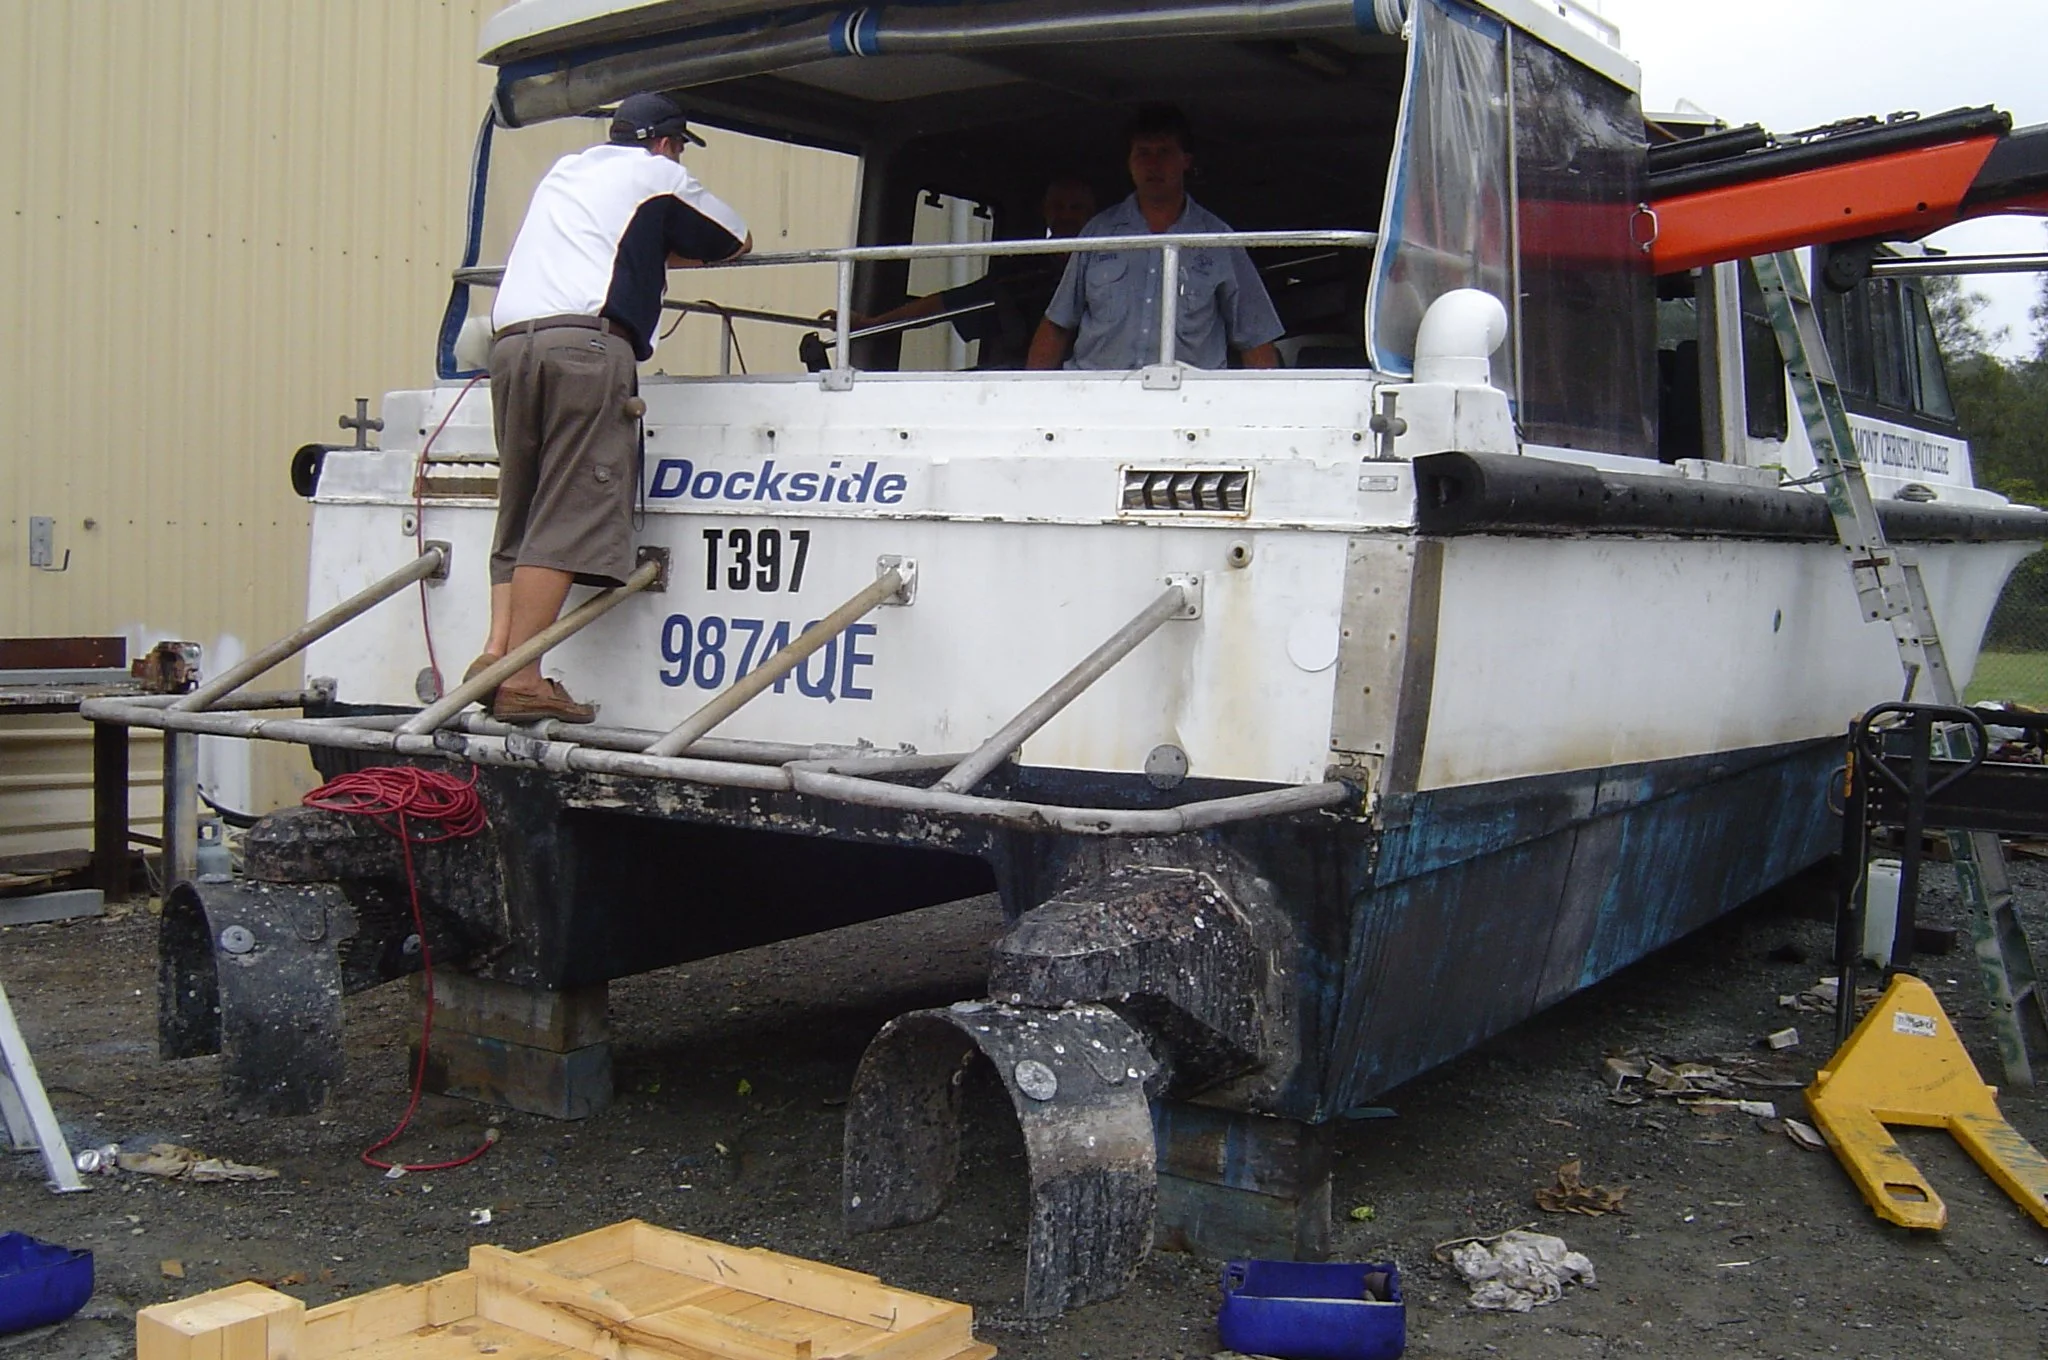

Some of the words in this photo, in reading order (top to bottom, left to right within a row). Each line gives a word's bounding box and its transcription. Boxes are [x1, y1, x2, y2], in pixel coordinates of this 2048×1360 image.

[649, 458, 907, 504] Dockside
[703, 528, 811, 593] T397
[659, 613, 878, 704] 9874QE
